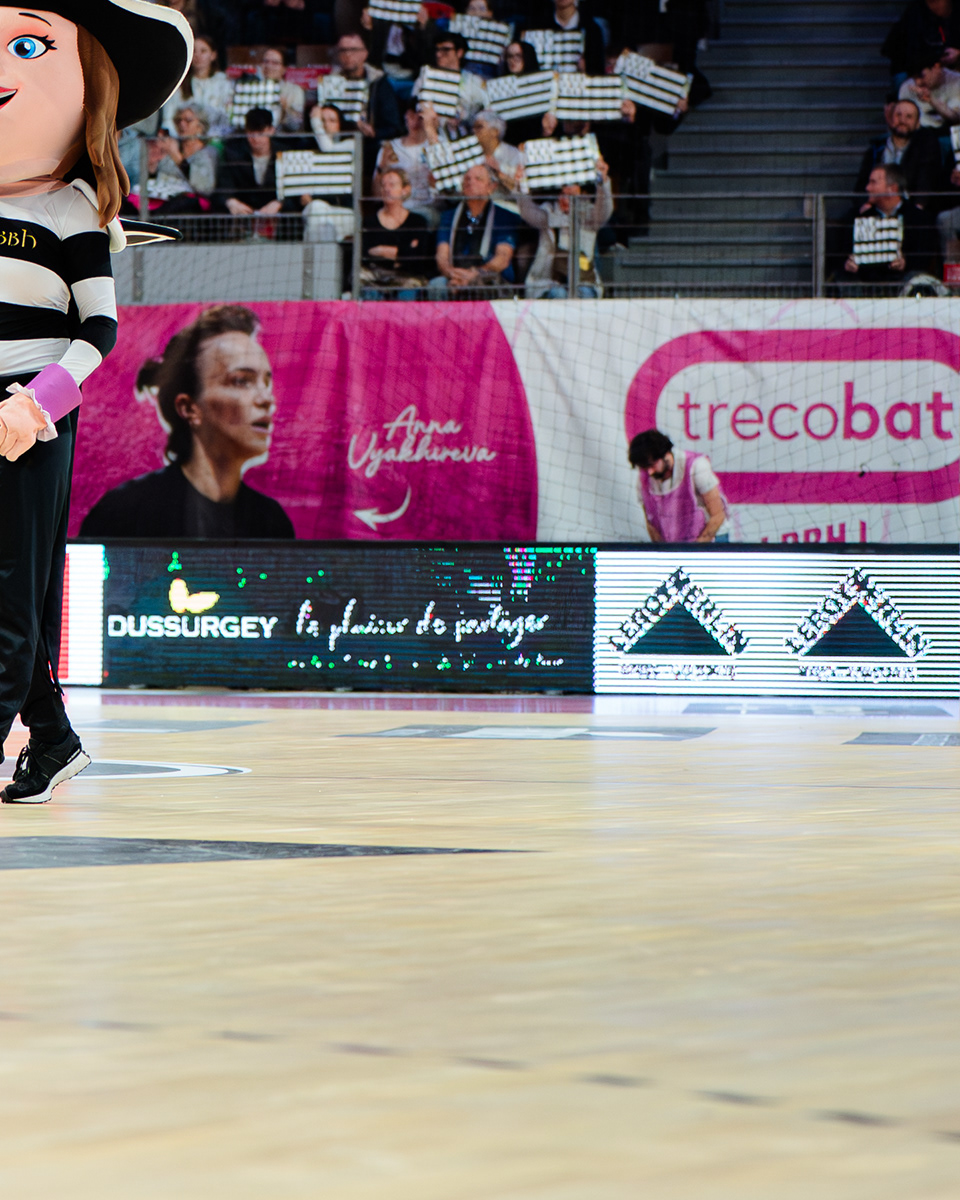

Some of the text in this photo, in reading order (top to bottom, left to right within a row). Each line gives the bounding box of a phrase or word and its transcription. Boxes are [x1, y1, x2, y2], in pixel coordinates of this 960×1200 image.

[383, 404, 463, 441] Anna
[678, 381, 954, 441] trecobat
[107, 614, 279, 639] DUSSURGEY
